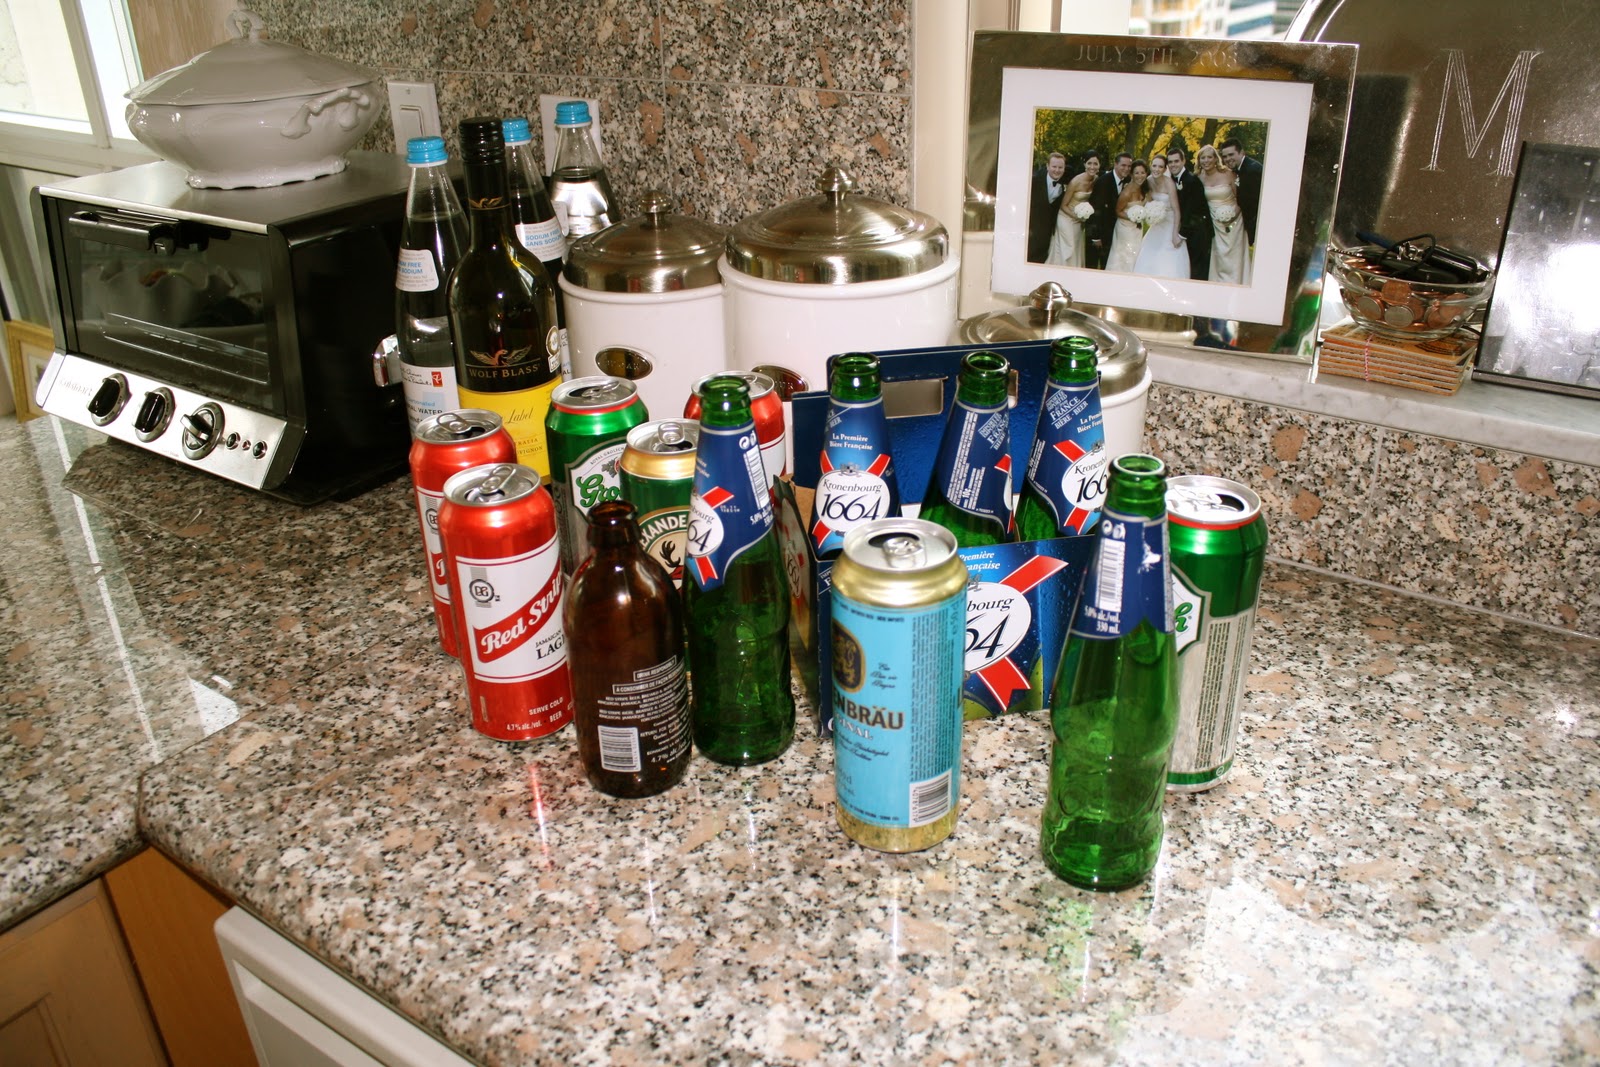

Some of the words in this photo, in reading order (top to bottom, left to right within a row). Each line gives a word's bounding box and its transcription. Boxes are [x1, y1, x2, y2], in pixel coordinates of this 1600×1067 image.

[1072, 44, 1127, 64] JULY
[1420, 48, 1544, 177] M
[468, 368, 499, 378] WOLF
[502, 364, 539, 378] BLASS
[504, 406, 534, 424] Label
[1050, 396, 1081, 421] FRANCE
[832, 432, 840, 440] La
[840, 433, 869, 442] Première
[822, 478, 882, 494] Kronenbourg
[1077, 465, 1108, 503] 166
[820, 493, 882, 521] 1664
[640, 514, 687, 551] EXANDE
[688, 518, 713, 552] 64
[480, 617, 527, 655] Red
[528, 567, 562, 626] Strip
[965, 612, 1011, 659] 64
[529, 704, 549, 715] SERVE
[549, 696, 563, 709] COLD
[506, 723, 521, 731] 4.7%
[549, 710, 562, 723] BEER
